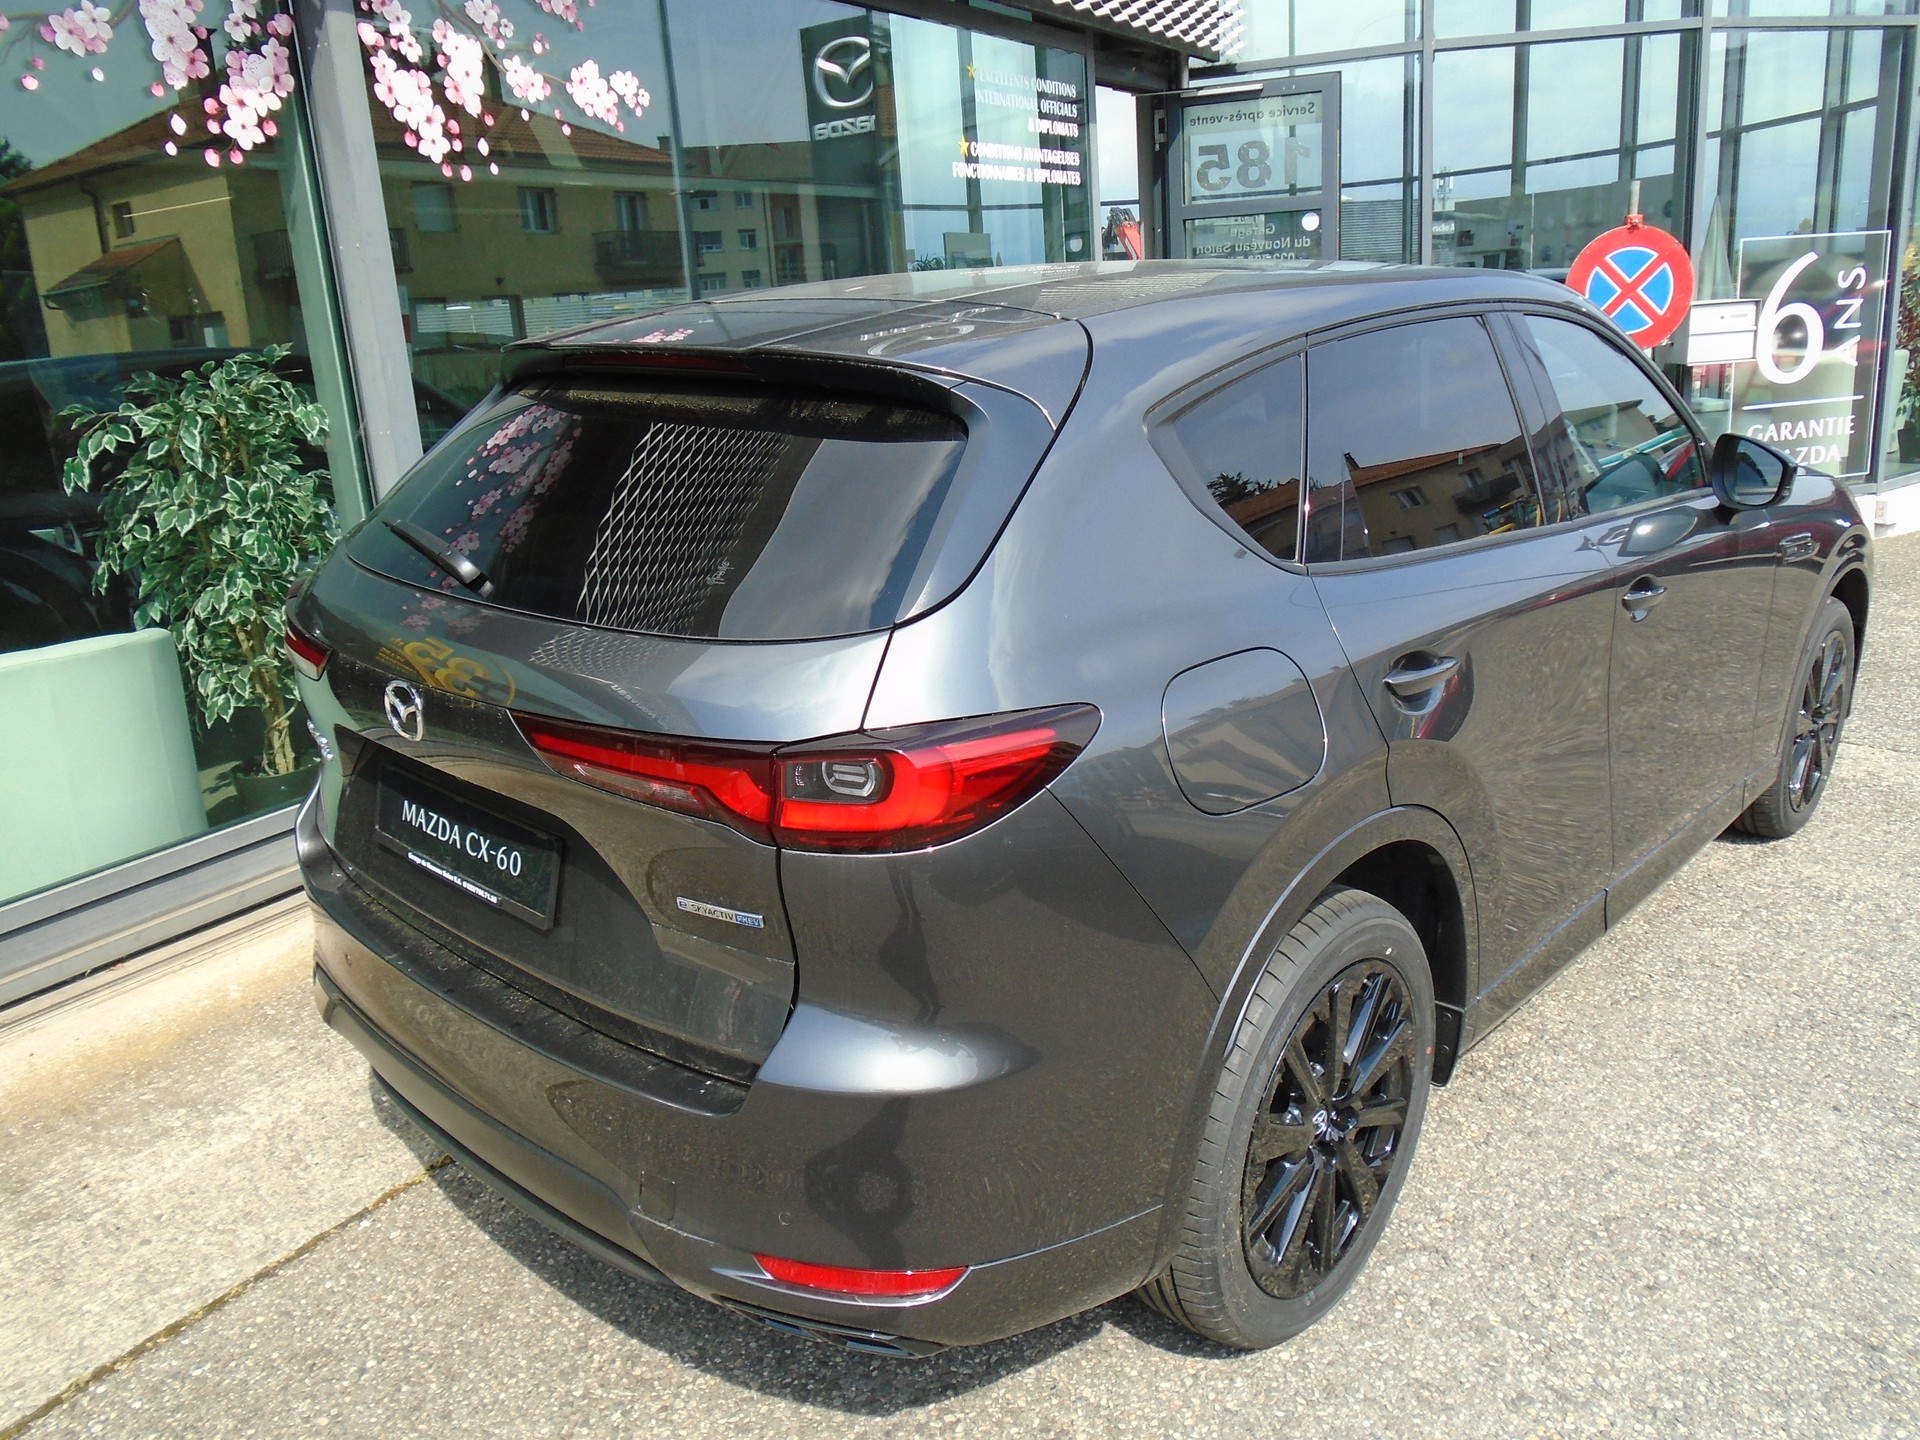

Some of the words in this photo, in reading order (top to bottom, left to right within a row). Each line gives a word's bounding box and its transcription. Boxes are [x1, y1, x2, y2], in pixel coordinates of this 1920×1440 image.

[1031, 78, 1077, 98] CONDITIONS
[975, 88, 1040, 113] INTERNATIONAL
[1040, 98, 1078, 118] OFFICIALS
[1035, 118, 1079, 138] DIPLOMATS
[1023, 146, 1080, 167] AVANTAGEUSES
[1034, 168, 1082, 186] DIPLOMATES
[1756, 250, 1825, 385] 6
[1830, 266, 1867, 367] ANS
[1746, 415, 1856, 442] GARANTIE
[1785, 443, 1842, 466] ZDA
[402, 800, 461, 849] MAZDA
[465, 832, 521, 876] CX-60
[691, 903, 734, 920] SKYACTIV
